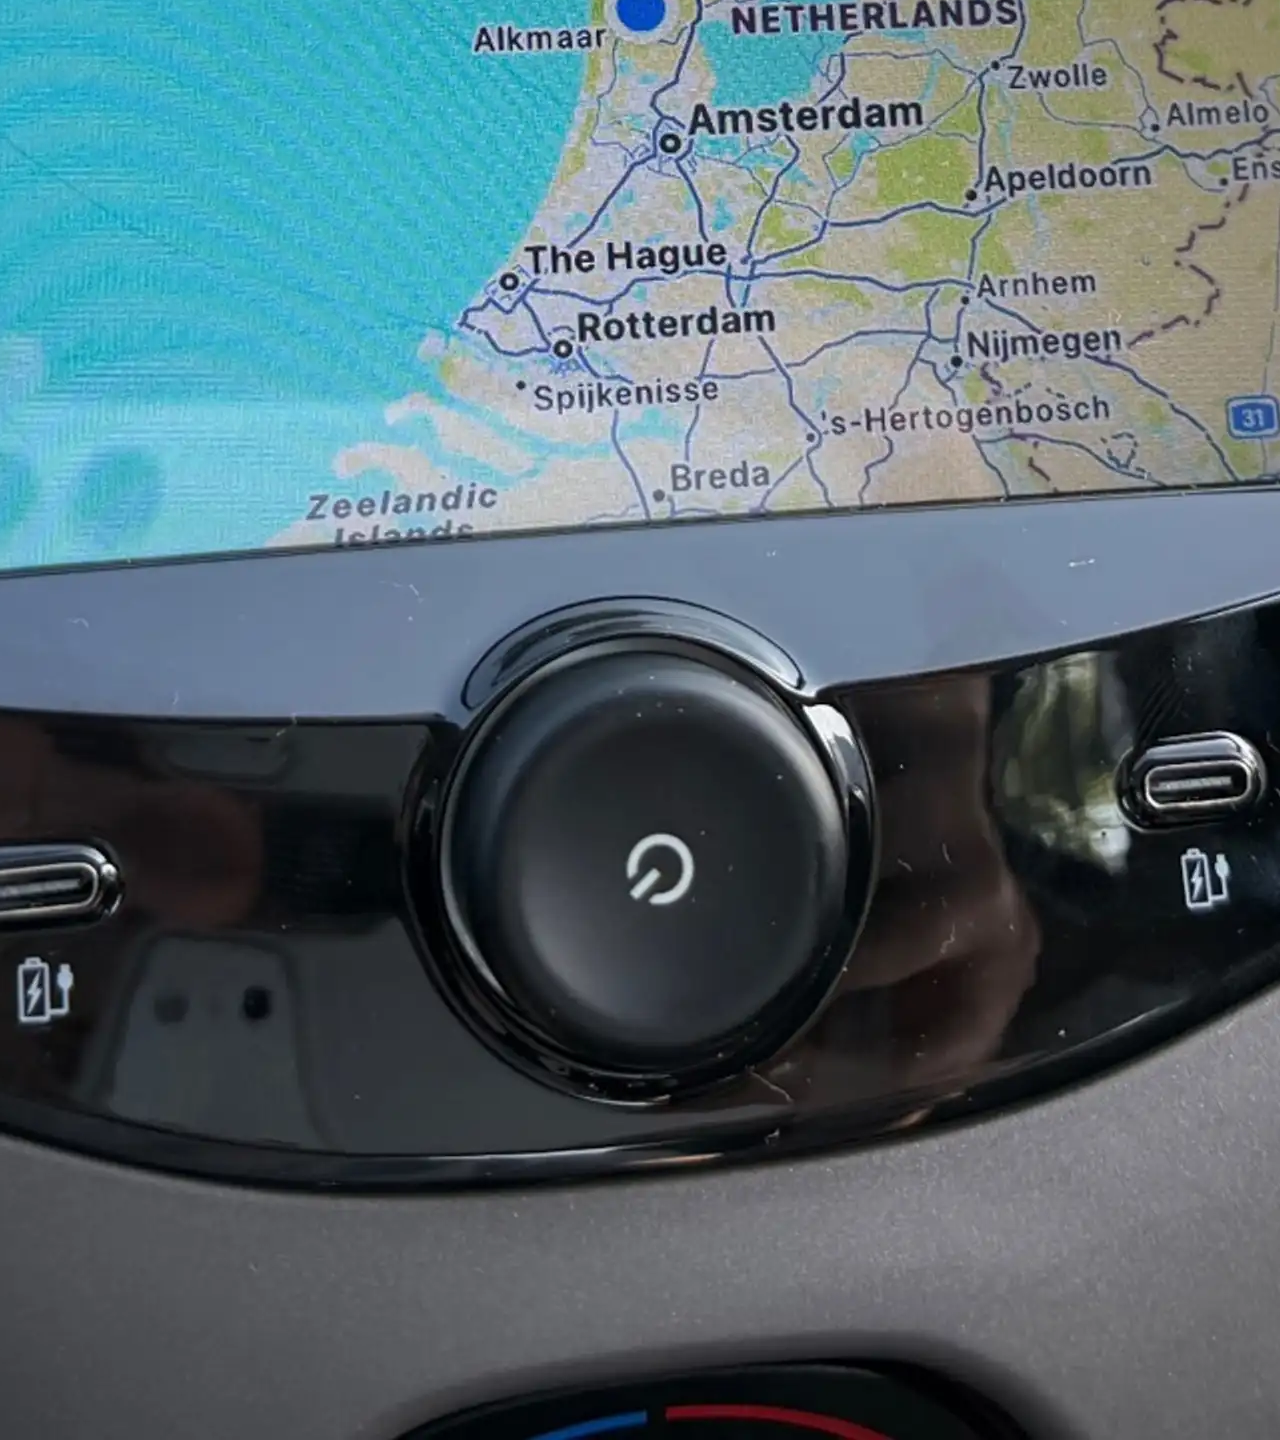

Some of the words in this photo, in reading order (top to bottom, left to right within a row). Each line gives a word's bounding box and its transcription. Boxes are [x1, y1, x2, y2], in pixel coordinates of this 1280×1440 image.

[474, 25, 607, 53] Alkmaar
[1008, 64, 1107, 90] Zwolle
[689, 98, 923, 135] Amsterdam
[1167, 101, 1269, 127] Almelo
[984, 161, 1152, 198] Apeldoorn
[525, 245, 595, 275] The
[607, 241, 727, 274] Hague
[977, 271, 1097, 298] Arnhem
[578, 305, 776, 342] Rotterdam
[967, 326, 1121, 360] Nijmegen
[533, 377, 719, 414] Spijkenisse
[821, 395, 1111, 436] 's-Hertogenbosch
[1242, 408, 1266, 429] 31
[672, 461, 770, 492] Breda
[306, 482, 497, 520] Zeelandic
